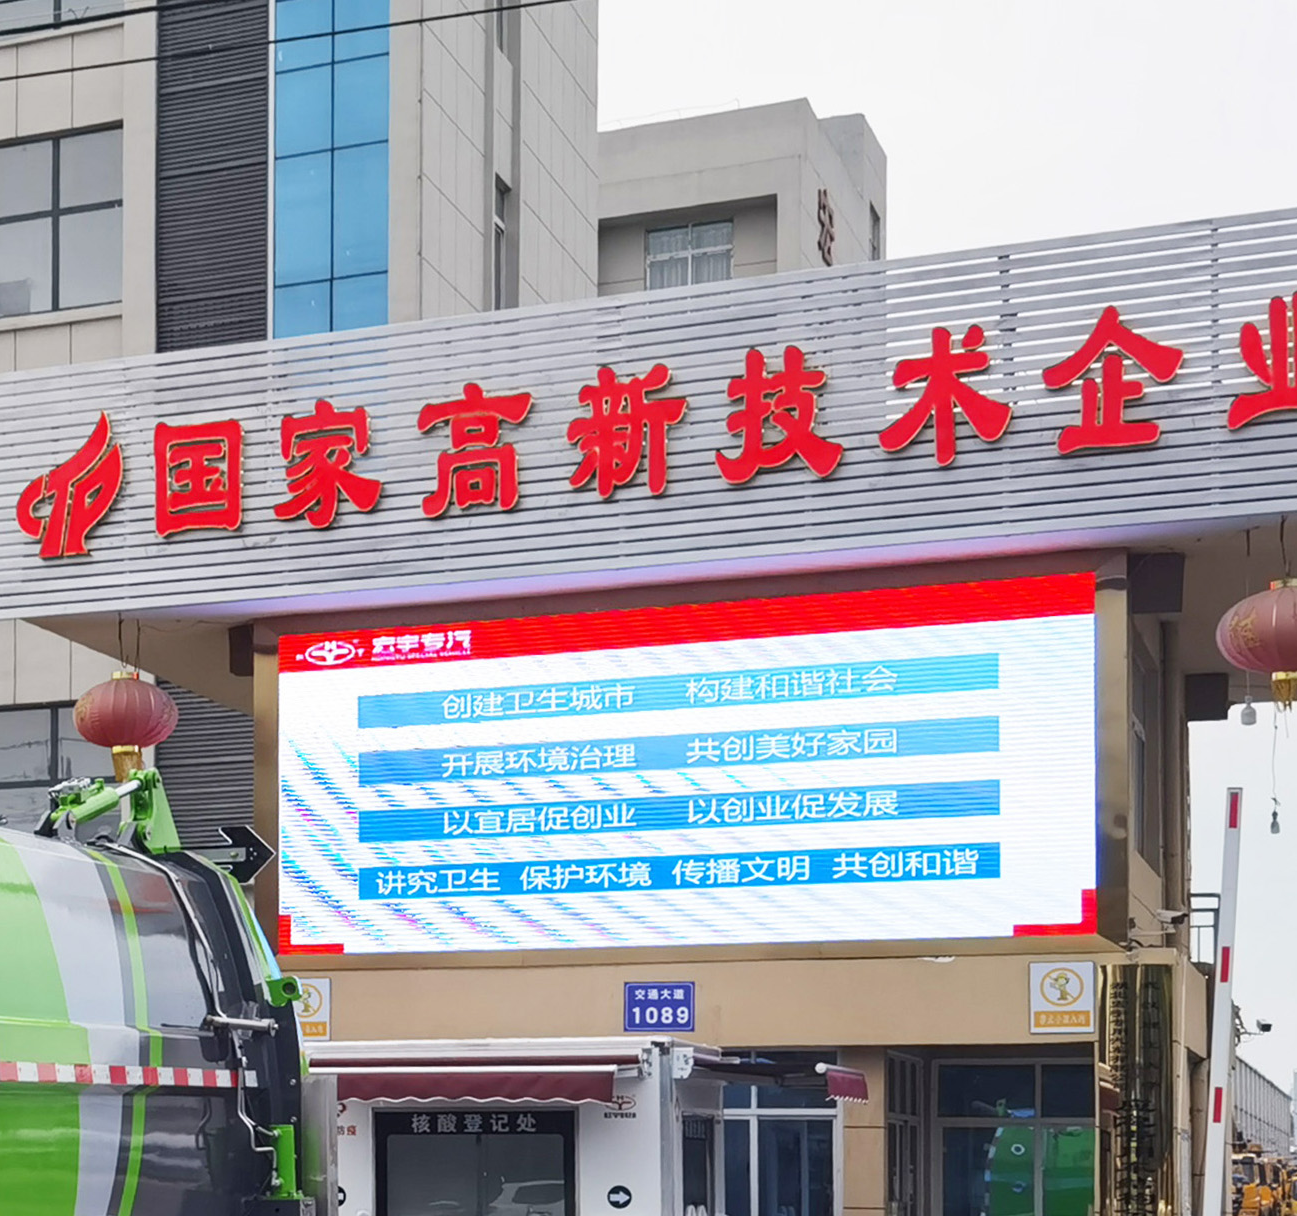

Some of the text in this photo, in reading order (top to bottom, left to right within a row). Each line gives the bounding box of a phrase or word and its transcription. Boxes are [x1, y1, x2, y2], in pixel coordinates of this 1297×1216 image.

[442, 665, 898, 719] 创建卫生城市 构建和谐社会
[441, 728, 898, 778] 开展环境治理 共创美好家园
[442, 790, 899, 836] 以宜居促创业 以创业促发展
[376, 849, 979, 895] 讲究卫生 保护环境 传播文明 共创和谐
[632, 1006, 689, 1024] 1089
[635, 989, 684, 1000] 交通大道
[412, 1114, 537, 1133] 核酸登记处
